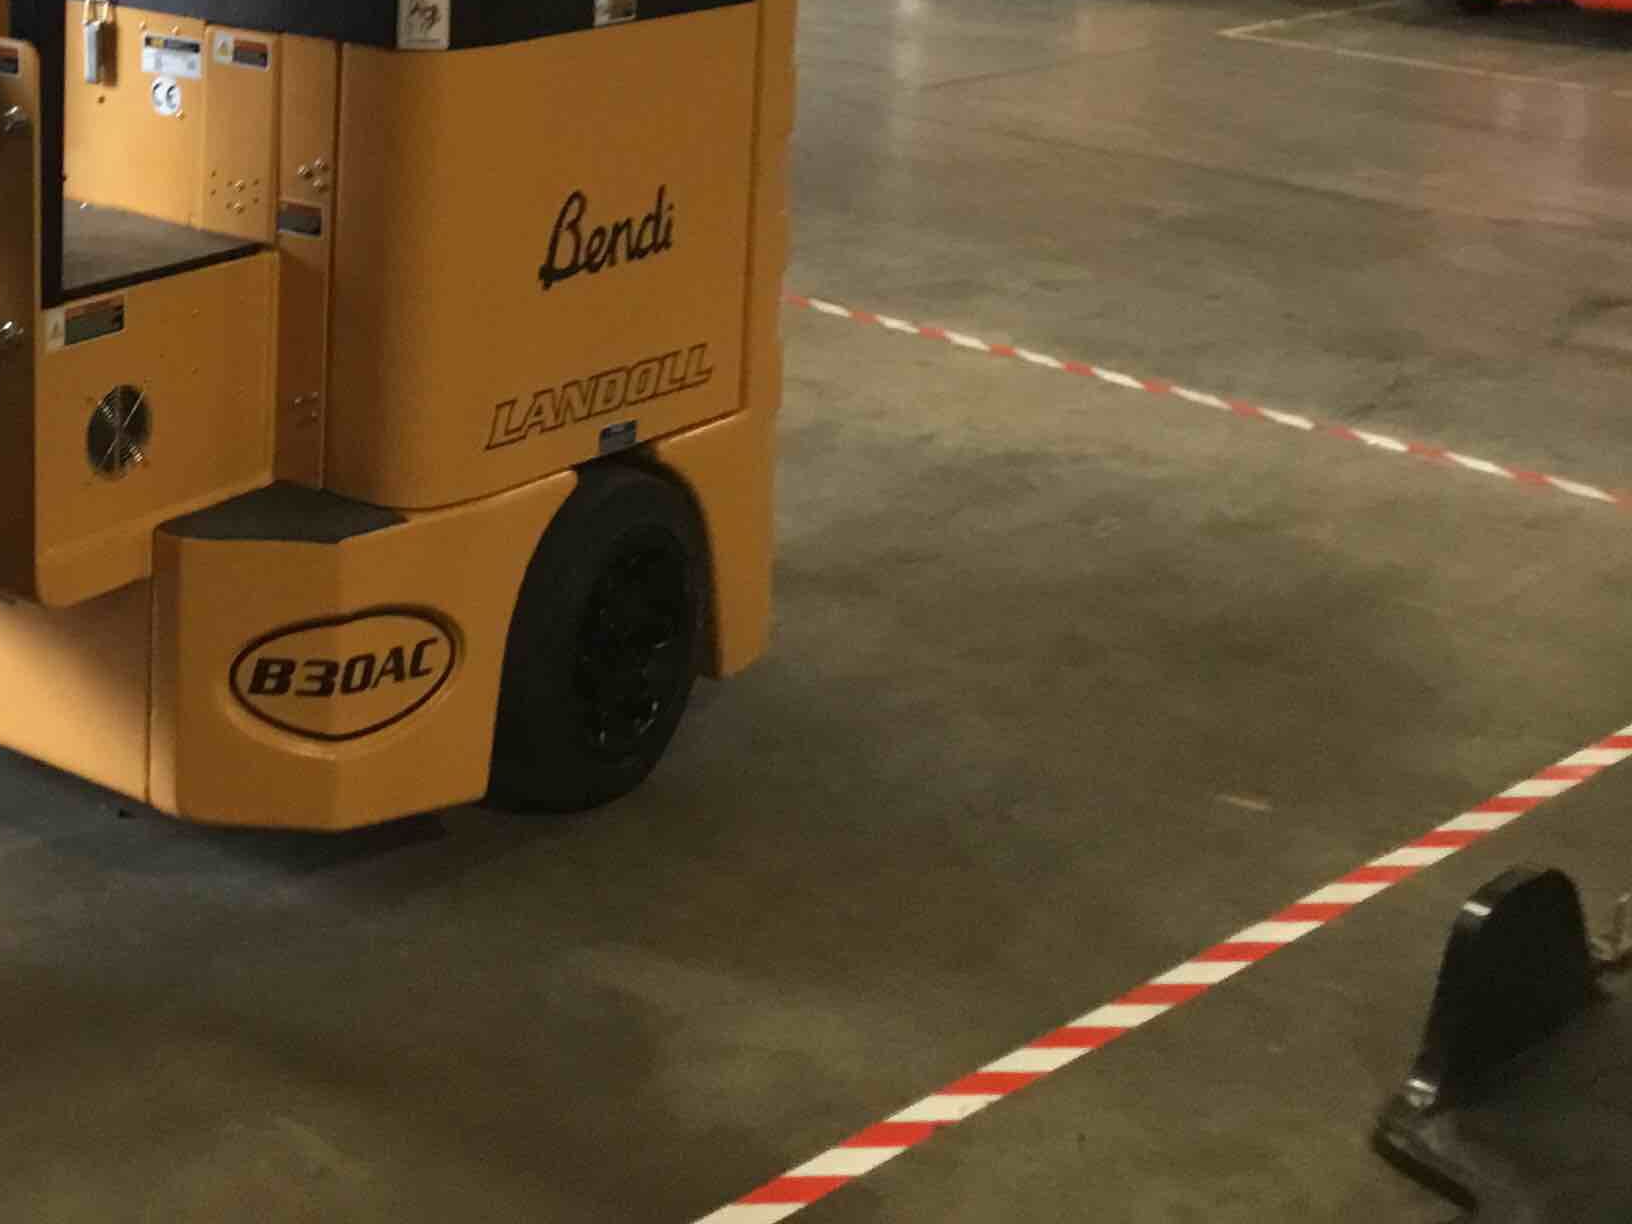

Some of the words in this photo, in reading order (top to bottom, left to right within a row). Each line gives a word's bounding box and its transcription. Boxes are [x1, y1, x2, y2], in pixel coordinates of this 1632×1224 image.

[538, 184, 675, 291] Bendi
[483, 341, 713, 451] LANDOLL
[247, 636, 438, 697] B30AC
